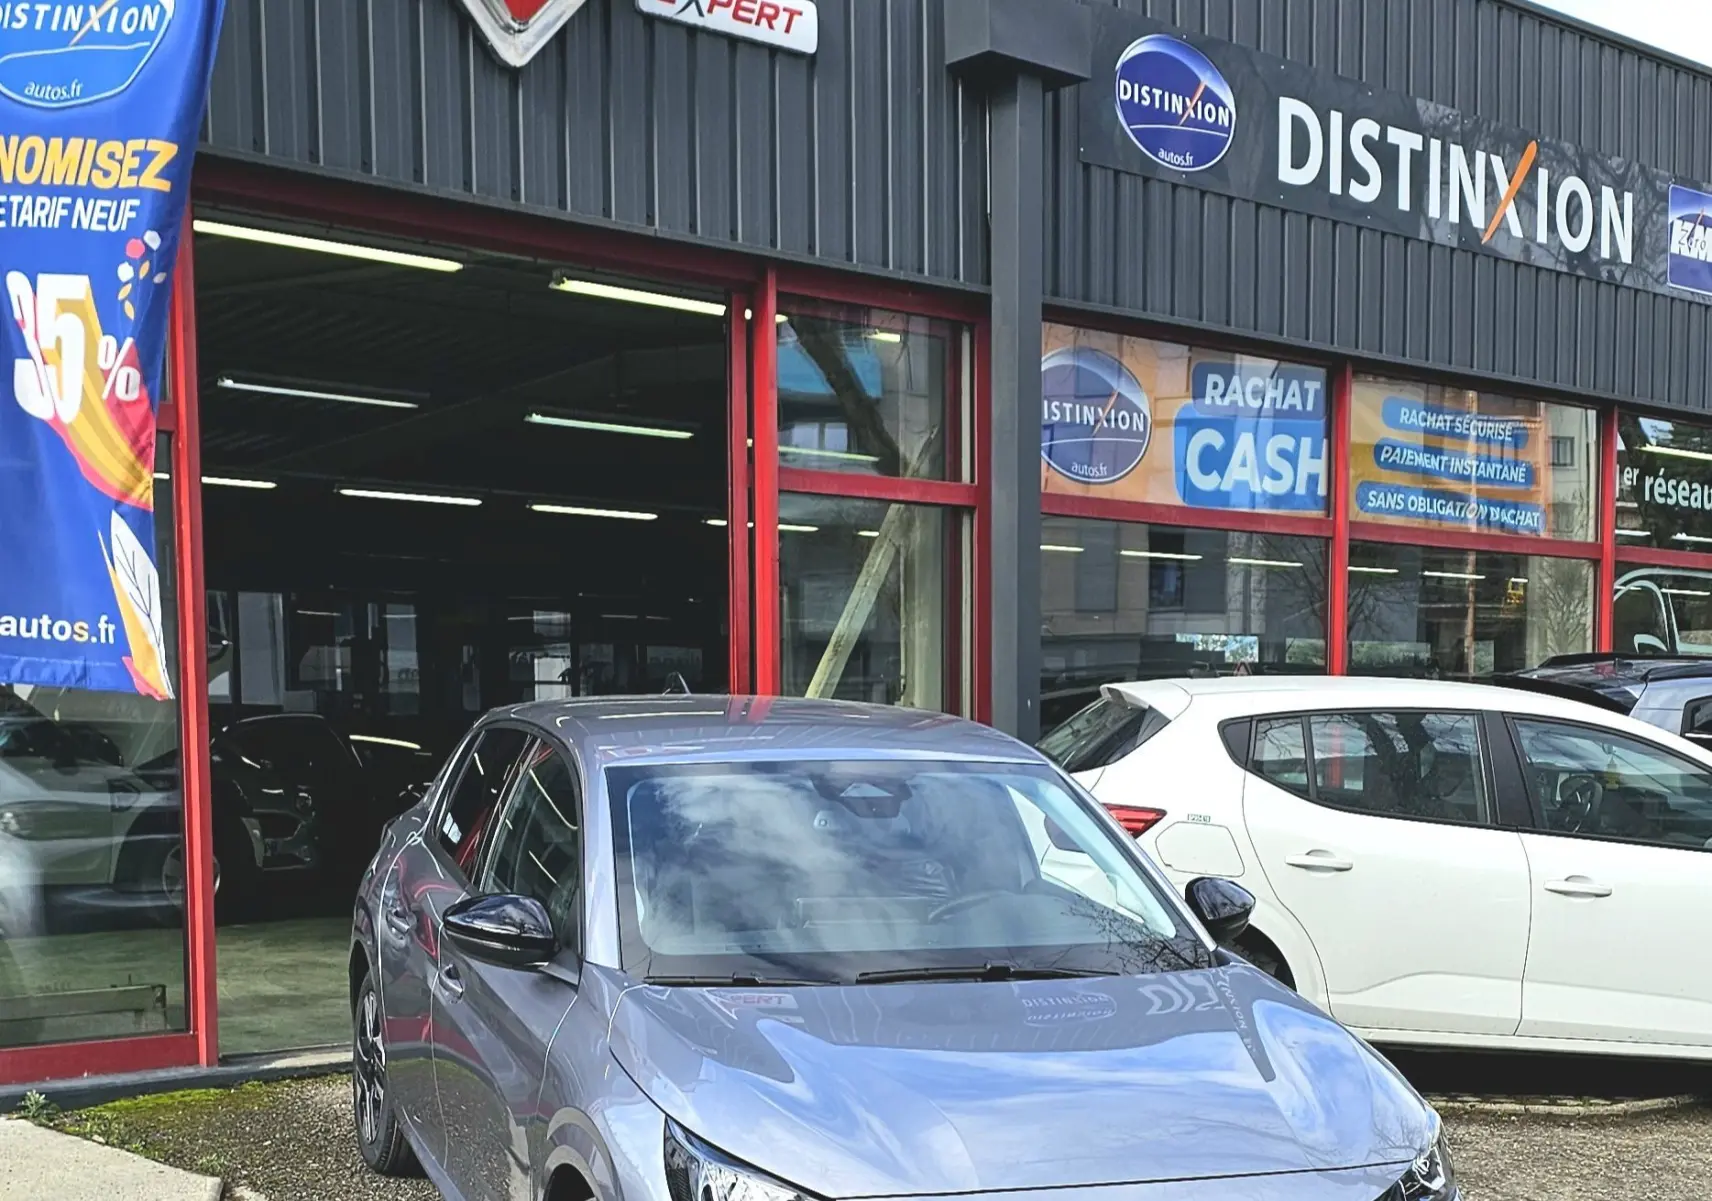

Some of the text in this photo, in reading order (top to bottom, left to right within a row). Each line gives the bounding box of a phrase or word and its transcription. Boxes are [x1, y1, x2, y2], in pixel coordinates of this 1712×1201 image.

[0, 2, 160, 36] ISTINXION
[656, 0, 803, 34] XPERT
[24, 79, 83, 100] autos.fr
[1119, 79, 1230, 128] DISTINXION
[1158, 148, 1194, 166] autos.fr
[1278, 96, 1633, 264] DISTINXION
[9, 195, 72, 229] TARIF
[71, 197, 140, 232] NEUF
[1205, 373, 1321, 411] RACHAT
[1400, 407, 1454, 432] RACHAT
[1071, 462, 1108, 477] autos.fr
[1185, 428, 1328, 497] CASH
[1380, 446, 1527, 483] PAIEMENT INSTANTANÉ
[1367, 490, 1405, 511] SANS
[1408, 495, 1487, 520] OBLIGATION
[0, 614, 116, 644] autos.fr
